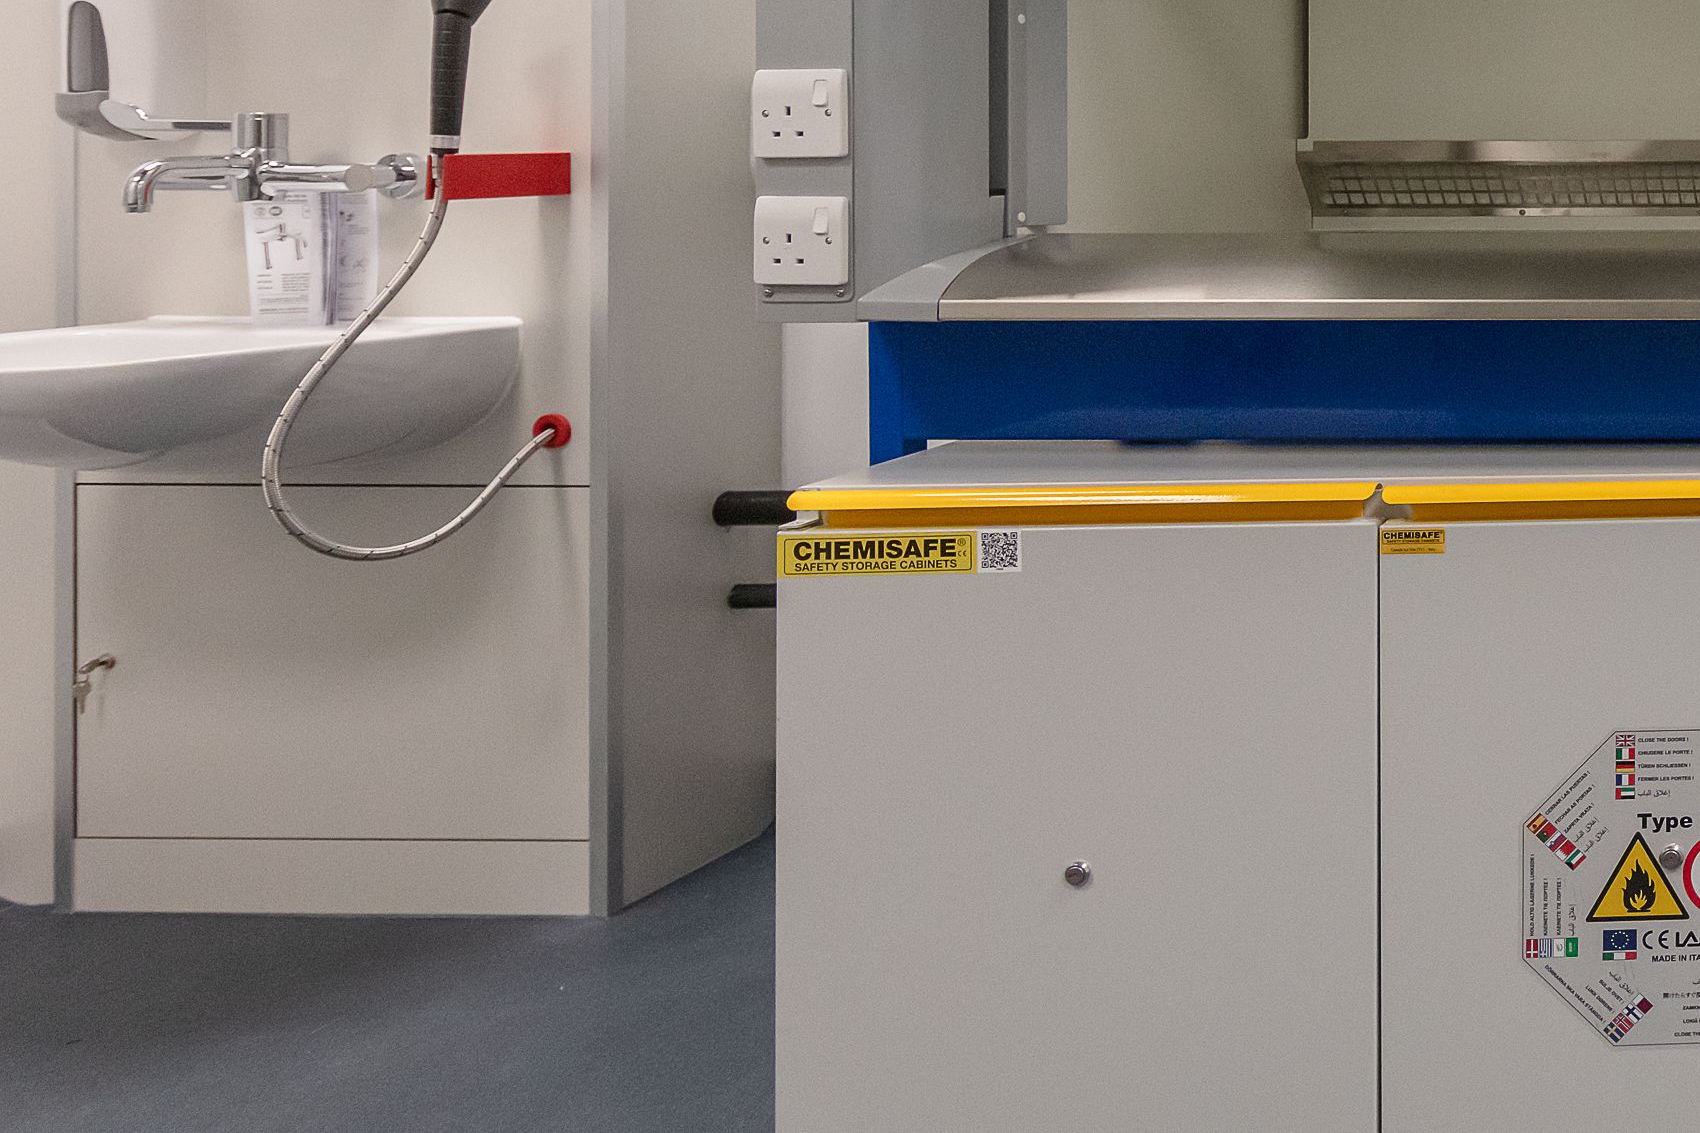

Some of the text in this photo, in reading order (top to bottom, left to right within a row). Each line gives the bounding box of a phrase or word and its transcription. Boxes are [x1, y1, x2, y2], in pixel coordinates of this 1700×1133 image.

[794, 559, 958, 572] SAFETY STORAGE CABINETS
[1636, 812, 1693, 833] Type
[1651, 955, 1677, 963] MADE
[1678, 954, 1689, 962] IN
